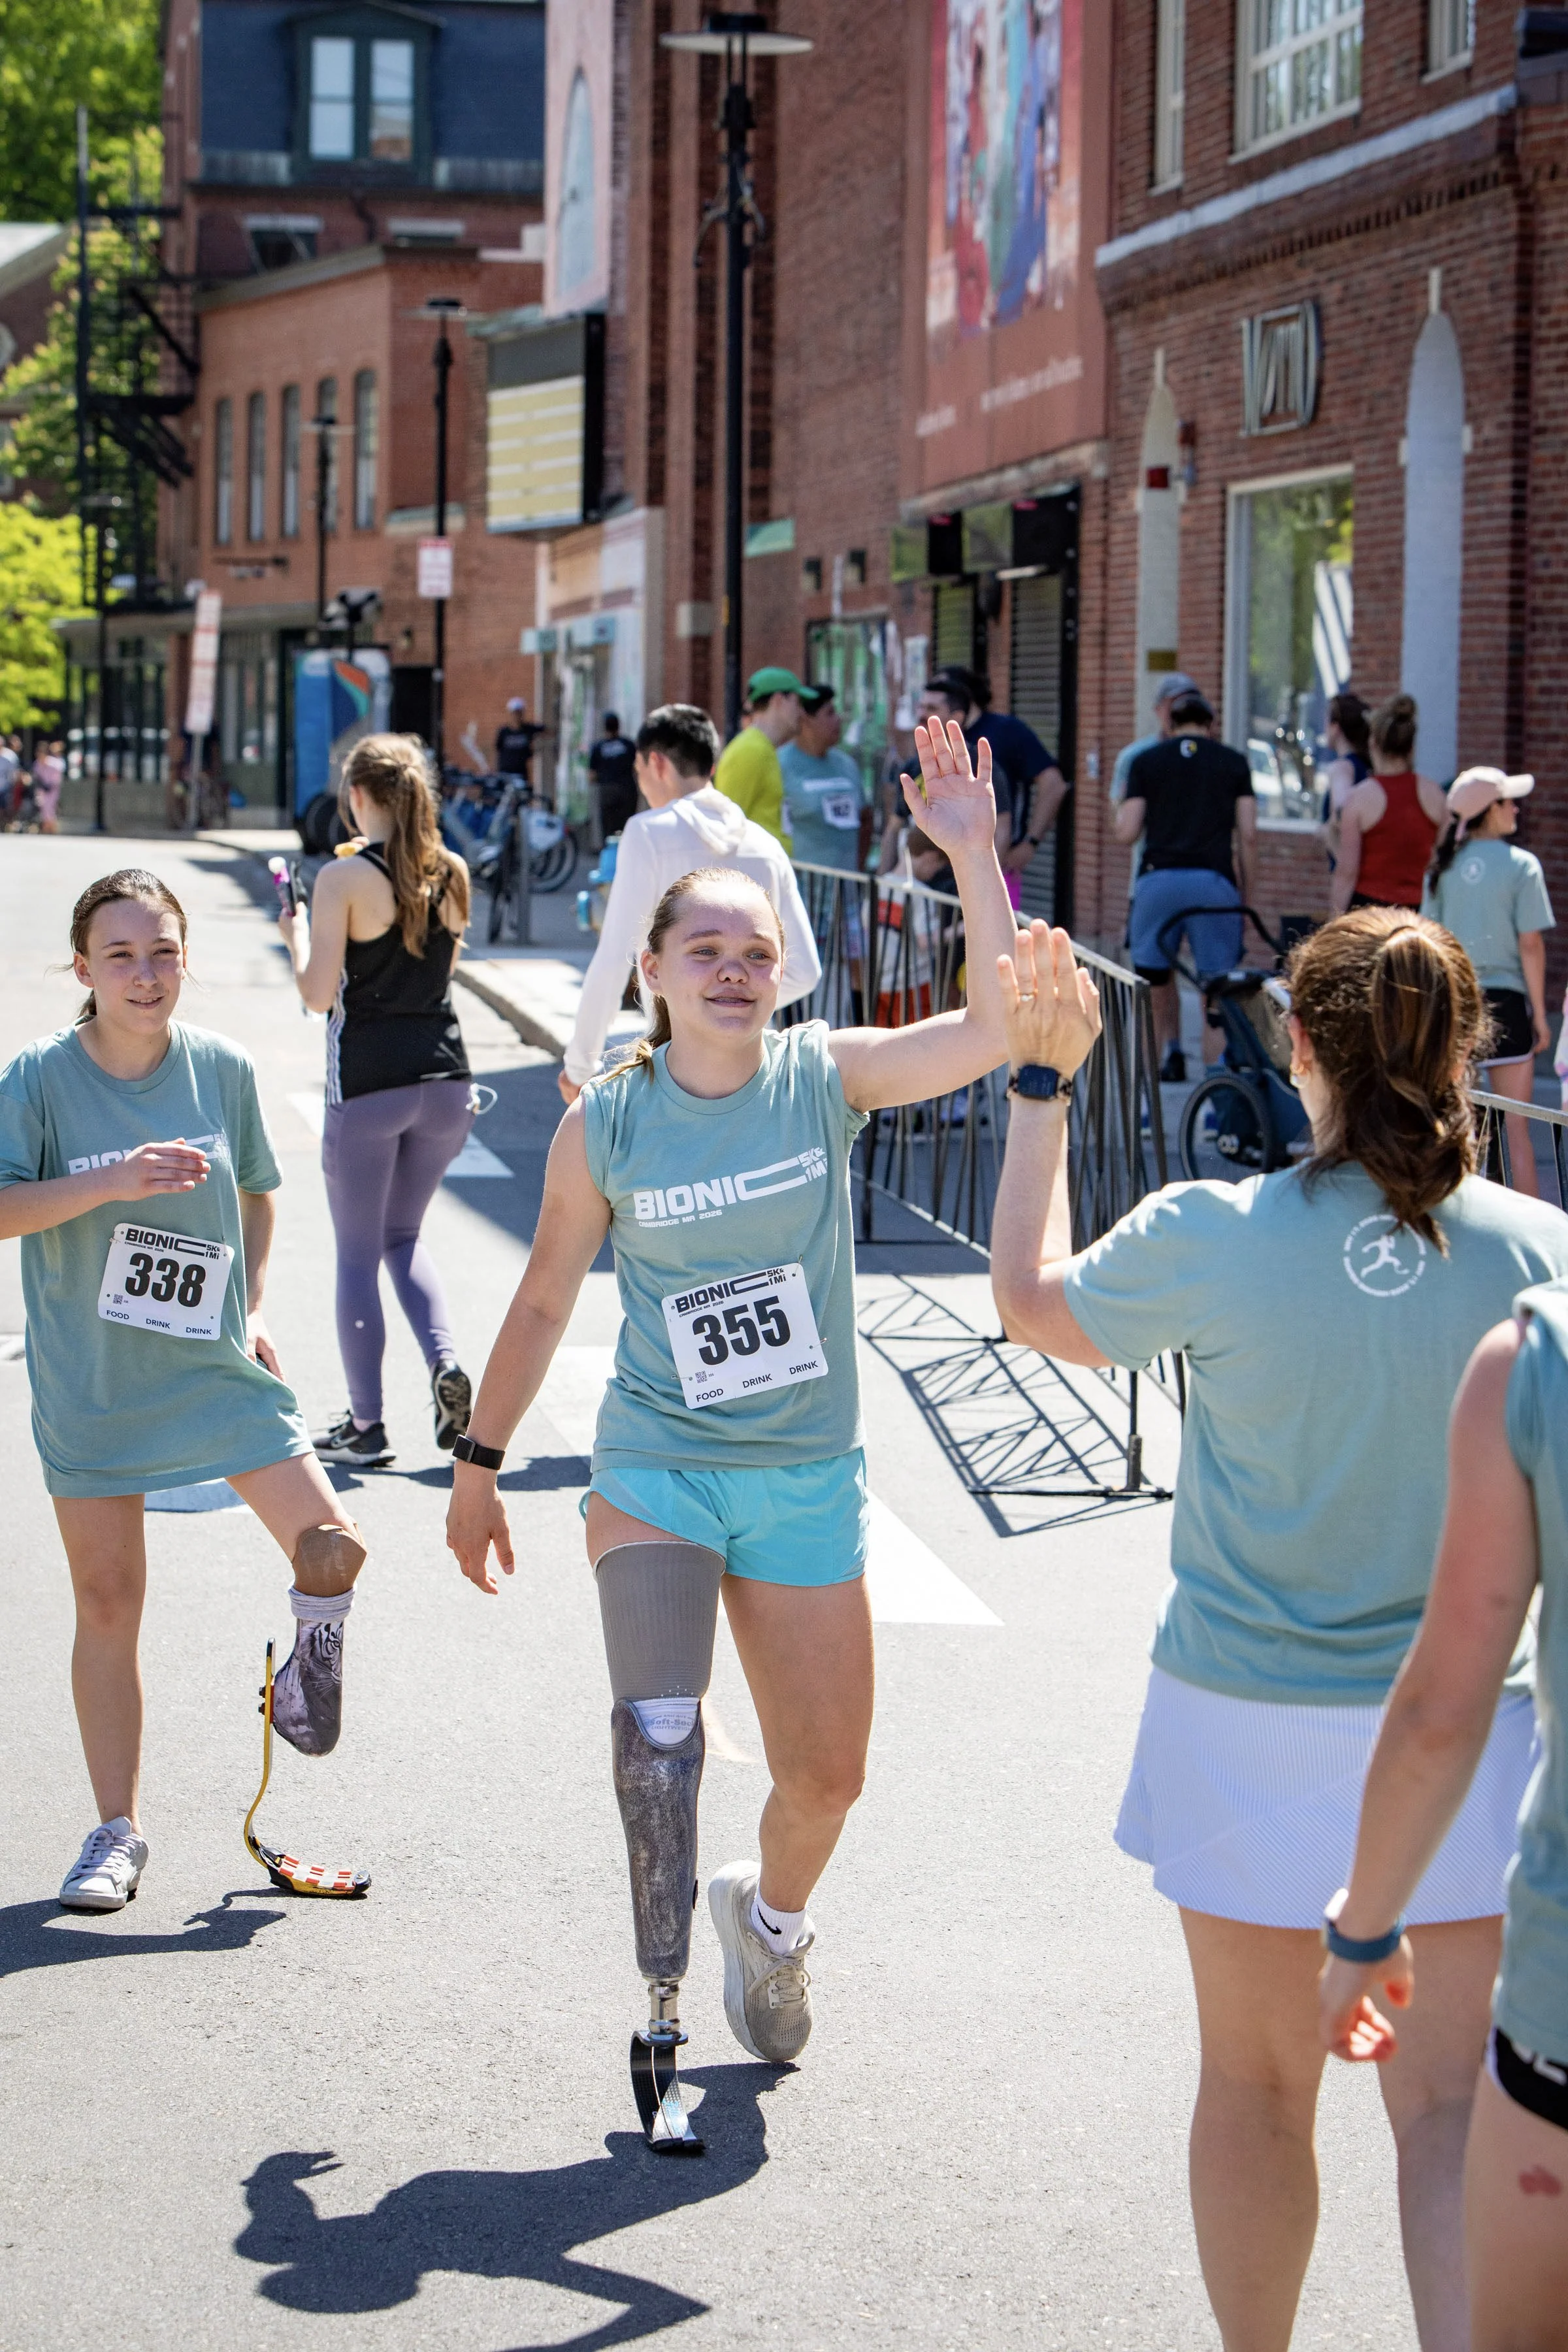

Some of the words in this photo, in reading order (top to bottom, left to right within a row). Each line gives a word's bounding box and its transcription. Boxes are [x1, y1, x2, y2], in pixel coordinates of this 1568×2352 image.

[797, 1147, 825, 1168] 5K&
[633, 1157, 808, 1220] BIONIC
[638, 1218, 679, 1228] CAMBRIDGE
[699, 1209, 723, 1220] 2026
[125, 1228, 207, 1256] BIONIC
[125, 1252, 206, 1307] 338
[767, 1268, 784, 1278] 5K&
[675, 1271, 769, 1313] BIONIC
[106, 1310, 129, 1320] FOOD
[146, 1318, 171, 1329] DRINK
[679, 1307, 702, 1318] CAMBRIDGE
[692, 1295, 791, 1365] 355
[696, 1388, 724, 1402] FOOD
[742, 1373, 773, 1388] DRINK
[789, 1360, 818, 1375] DRINK
